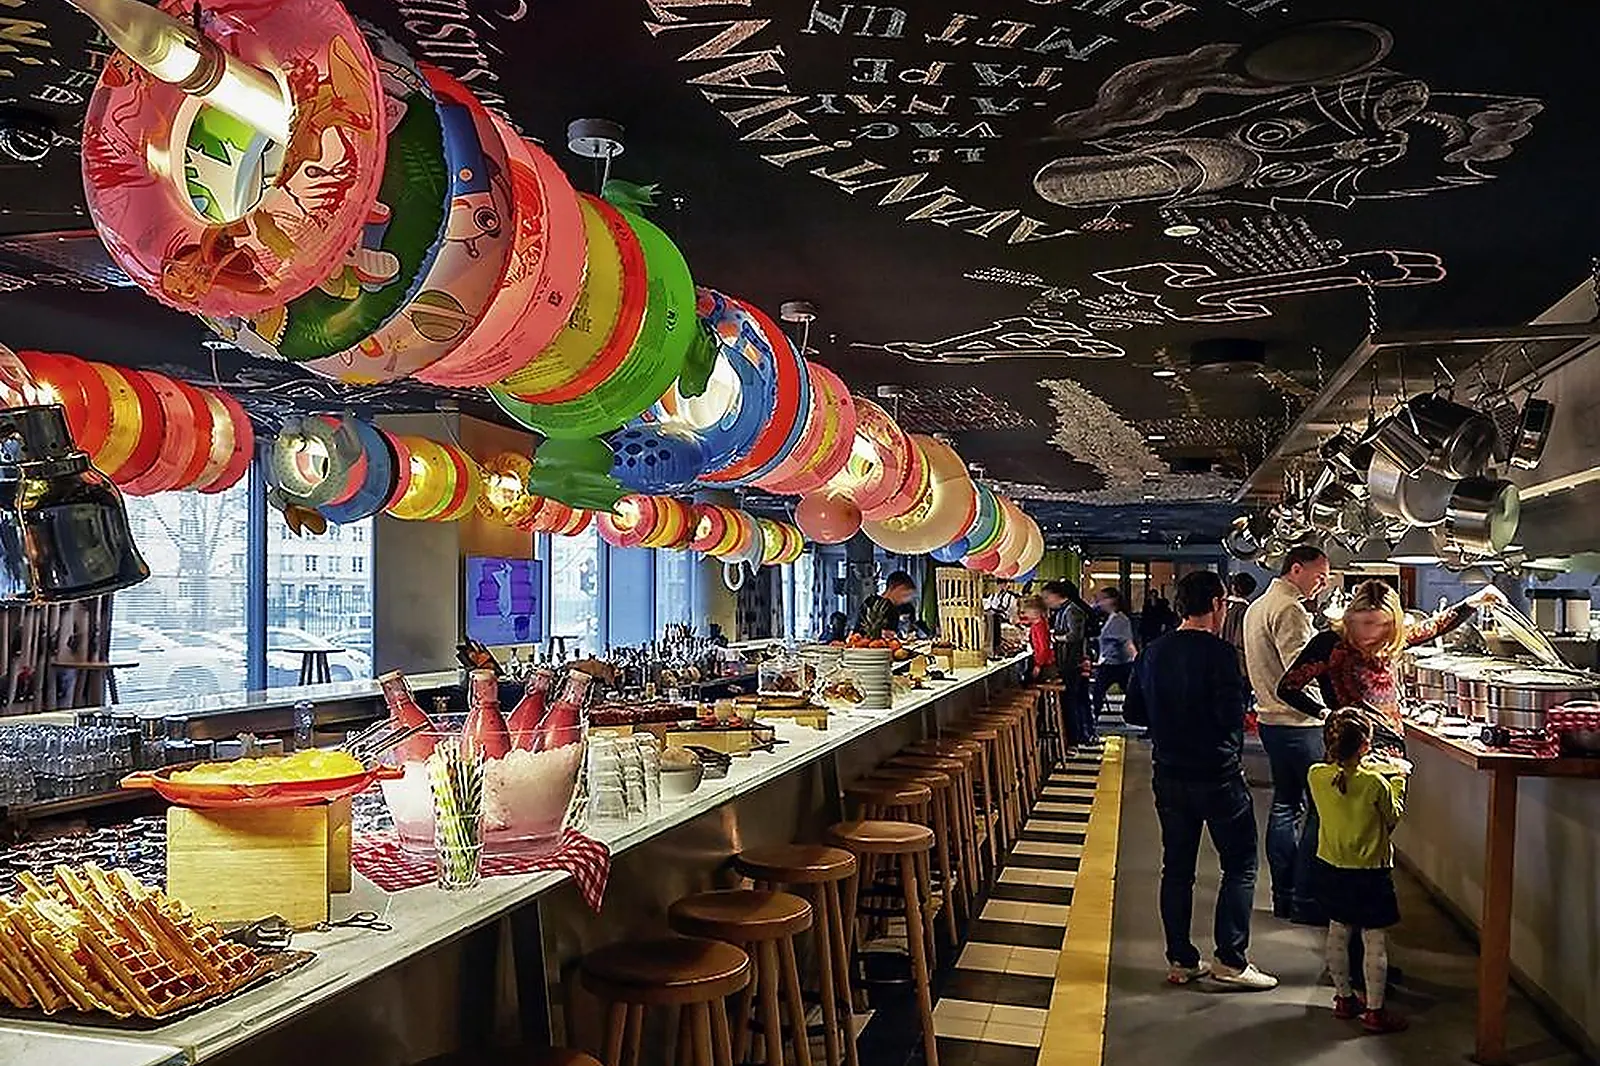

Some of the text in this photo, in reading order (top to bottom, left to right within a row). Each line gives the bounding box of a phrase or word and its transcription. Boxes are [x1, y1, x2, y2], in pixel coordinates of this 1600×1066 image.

[800, 0, 908, 39] UN
[924, 12, 1121, 62] MET
[852, 58, 1064, 91] TAPE
[912, 148, 986, 163] LE
